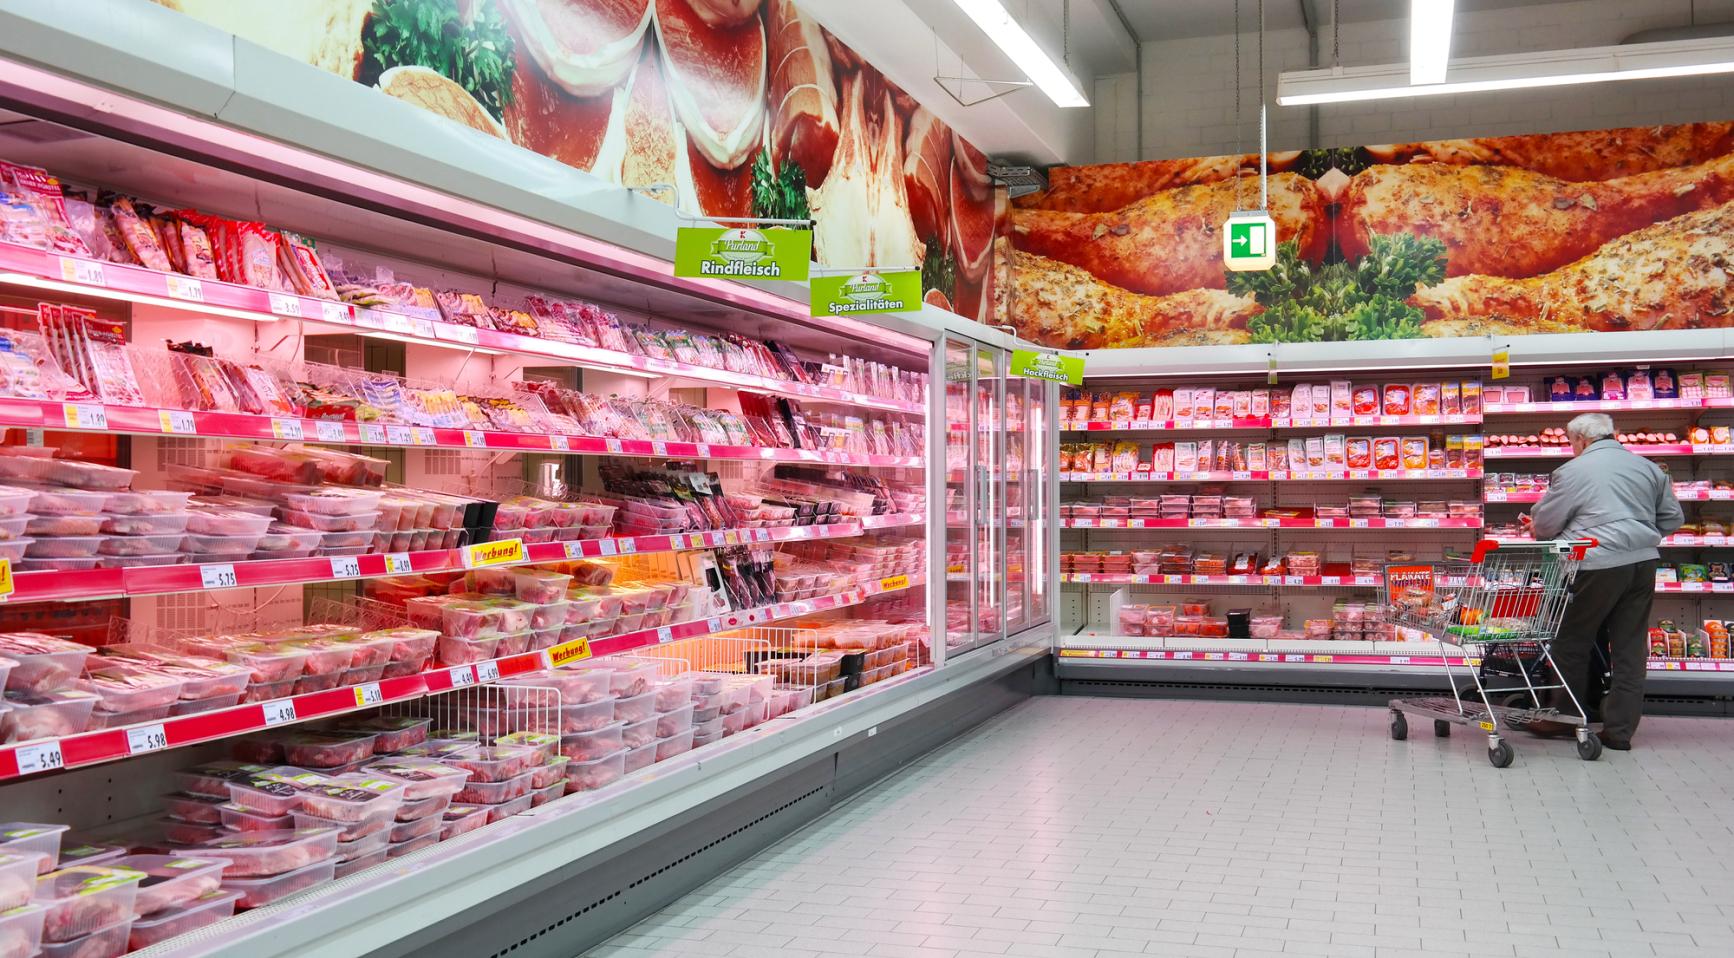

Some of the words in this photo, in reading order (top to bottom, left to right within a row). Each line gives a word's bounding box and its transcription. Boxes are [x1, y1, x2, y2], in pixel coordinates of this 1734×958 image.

[701, 260, 780, 276] Rindfleisch
[828, 299, 904, 315] Spezialitäten
[1023, 367, 1069, 381] Hackfleisch
[345, 563, 360, 577] 5.75
[218, 572, 236, 587] 5.75
[552, 641, 587, 662] Werbung!
[487, 668, 499, 680] 6.99
[279, 707, 296, 721] 4.98
[147, 733, 166, 748] 5.98
[40, 751, 61, 768] 5.49
